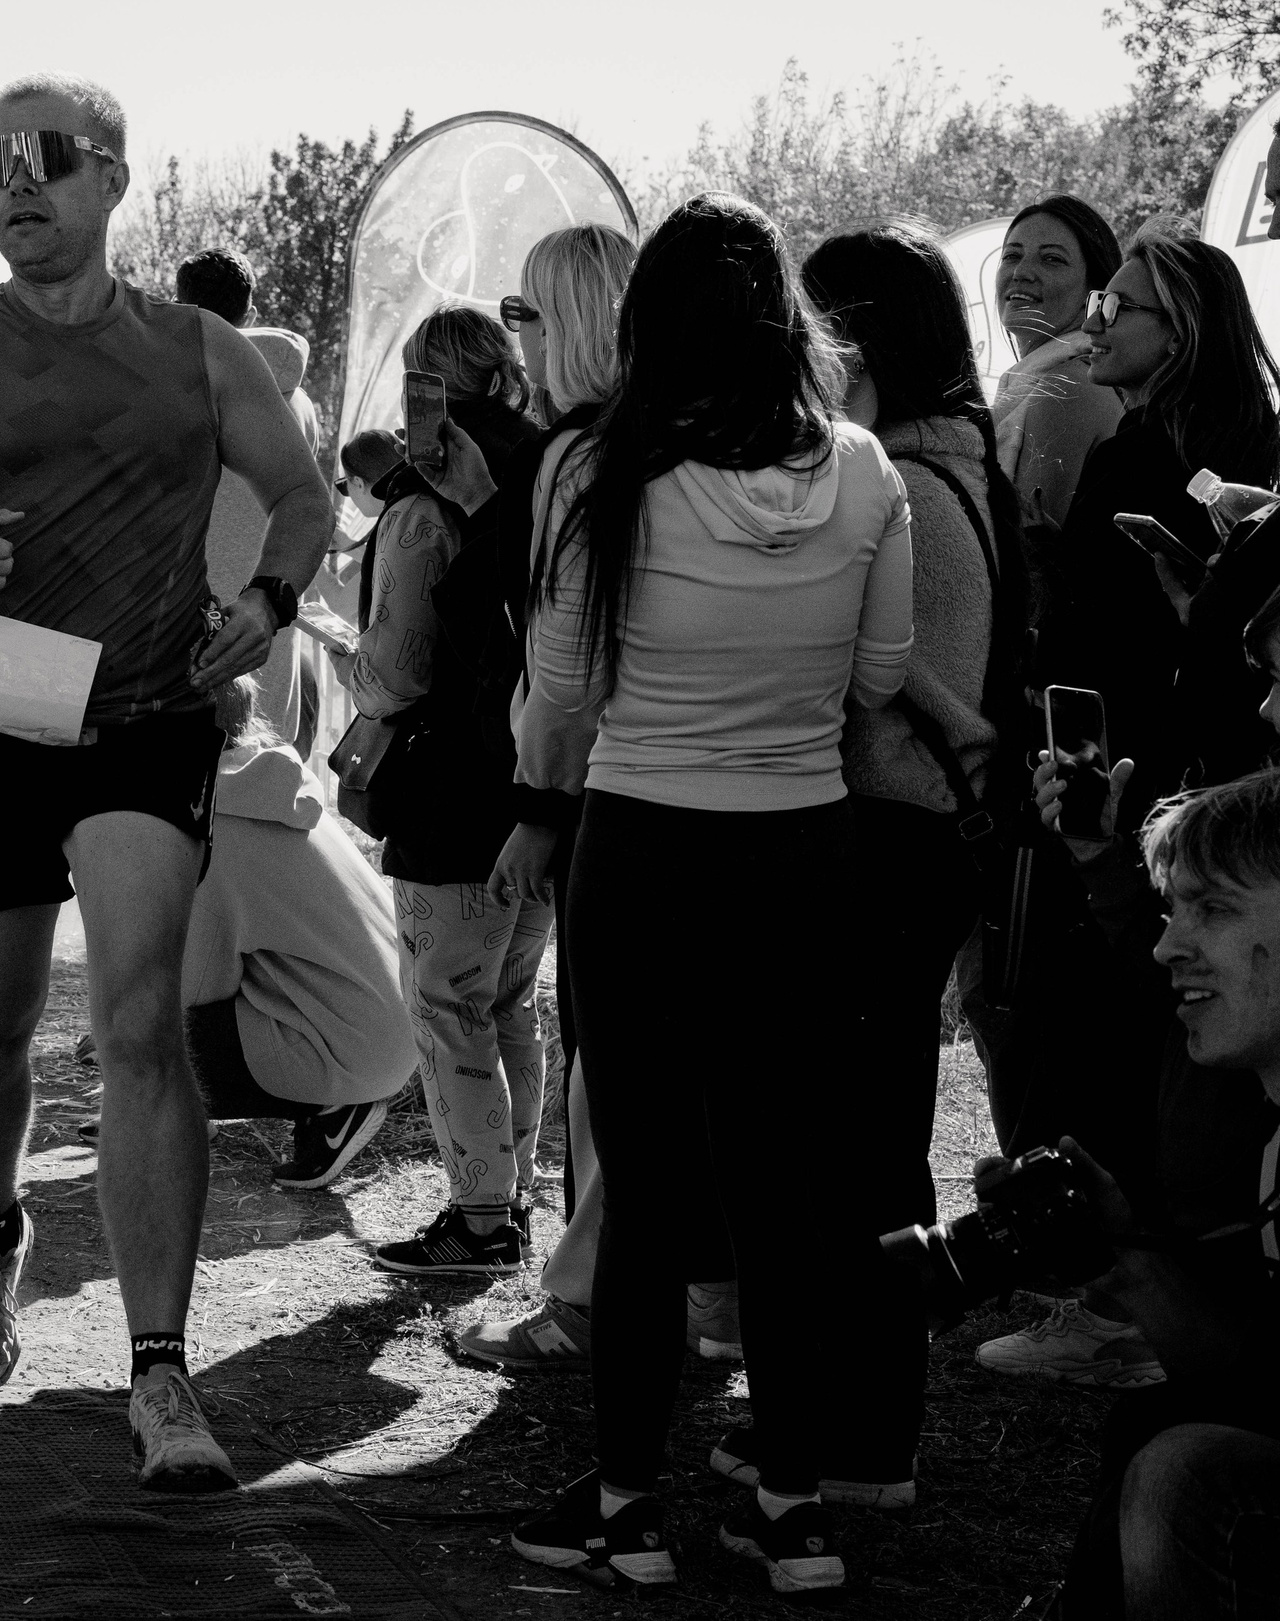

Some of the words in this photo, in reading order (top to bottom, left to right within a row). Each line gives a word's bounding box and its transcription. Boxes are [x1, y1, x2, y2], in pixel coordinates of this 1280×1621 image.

[448, 965, 482, 987] MOSCHINO
[455, 1064, 493, 1081] MOSCHINO
[585, 1537, 607, 1550] PUMA
